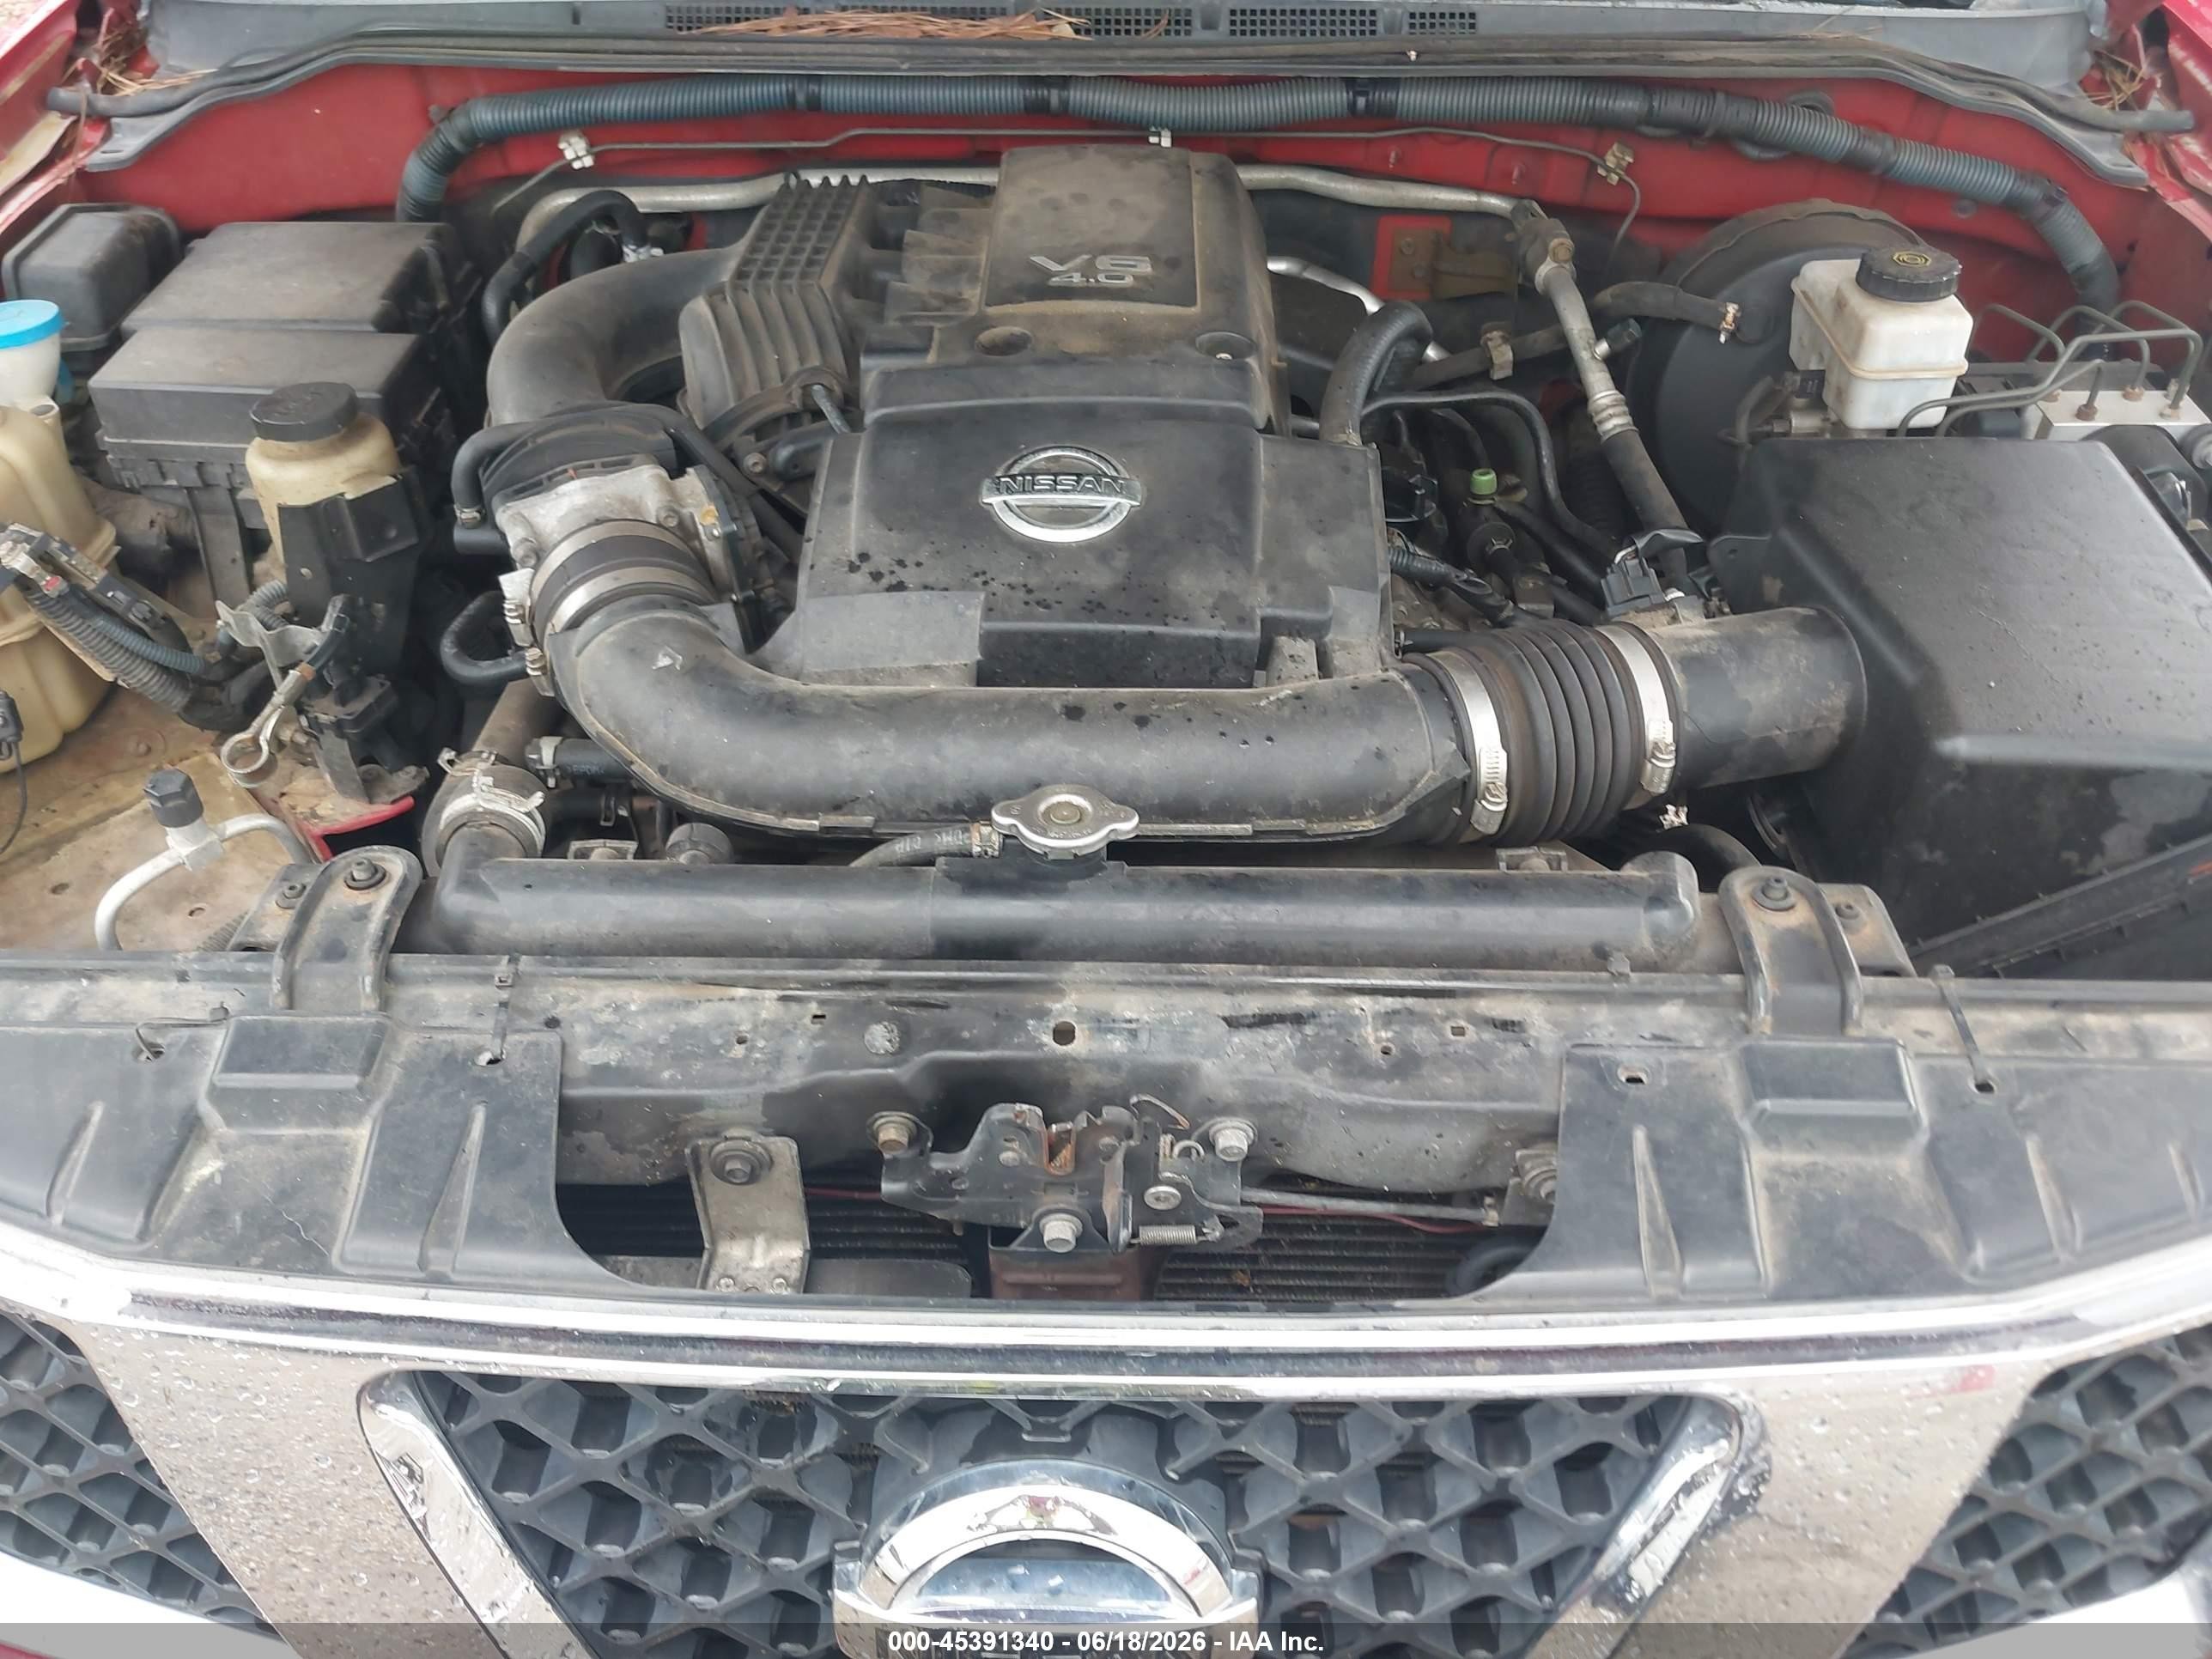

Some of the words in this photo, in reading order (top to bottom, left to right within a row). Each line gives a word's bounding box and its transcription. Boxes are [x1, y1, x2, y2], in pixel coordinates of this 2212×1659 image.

[1030, 254, 1153, 273] V6
[1048, 272, 1134, 287] 4.0
[998, 475, 1127, 495] NISSAN
